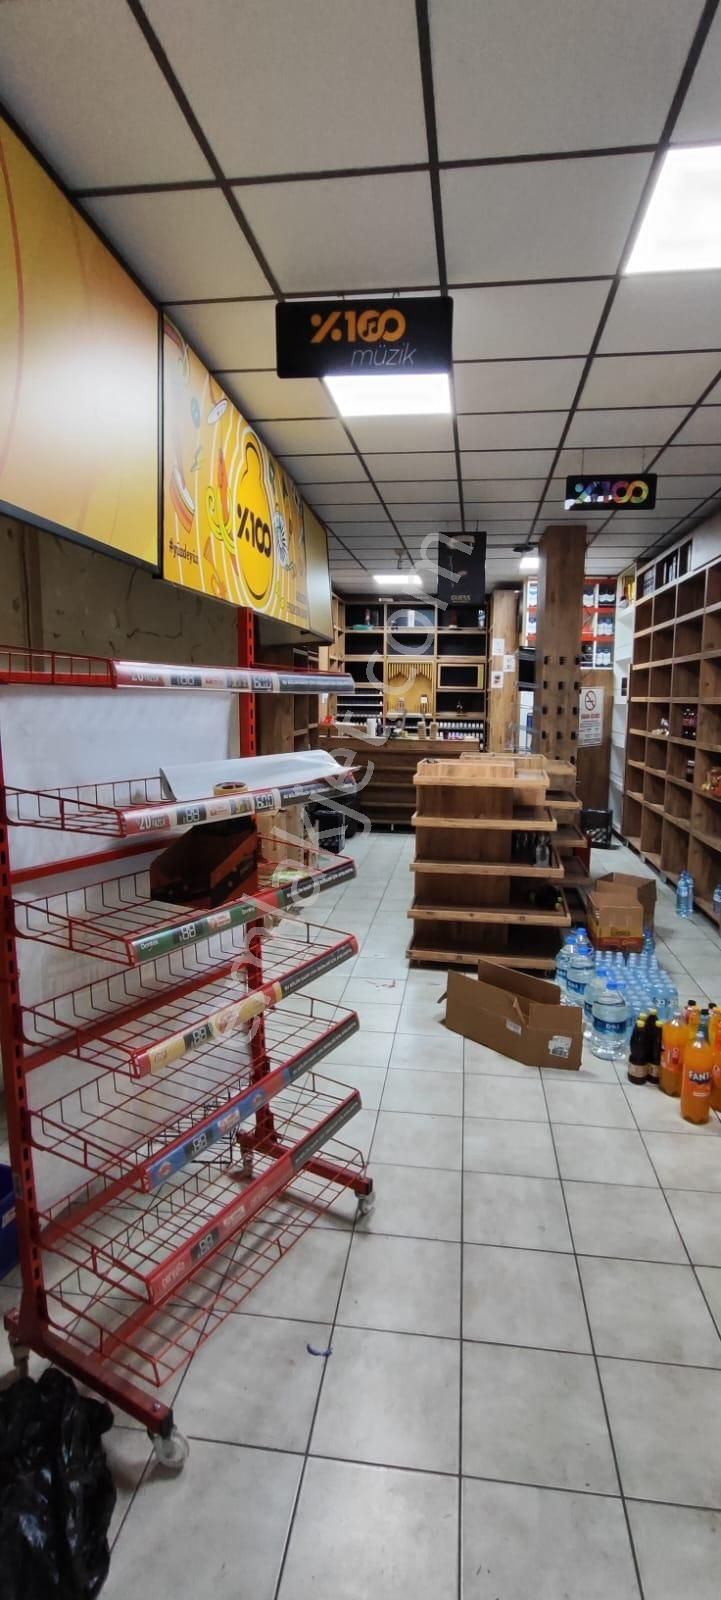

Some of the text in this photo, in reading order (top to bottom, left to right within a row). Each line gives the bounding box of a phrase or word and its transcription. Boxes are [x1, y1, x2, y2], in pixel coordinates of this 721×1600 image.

[310, 309, 406, 344] %100
[351, 342, 417, 367] müzik
[237, 503, 272, 559] %100
[688, 1070, 711, 1081] FANT
